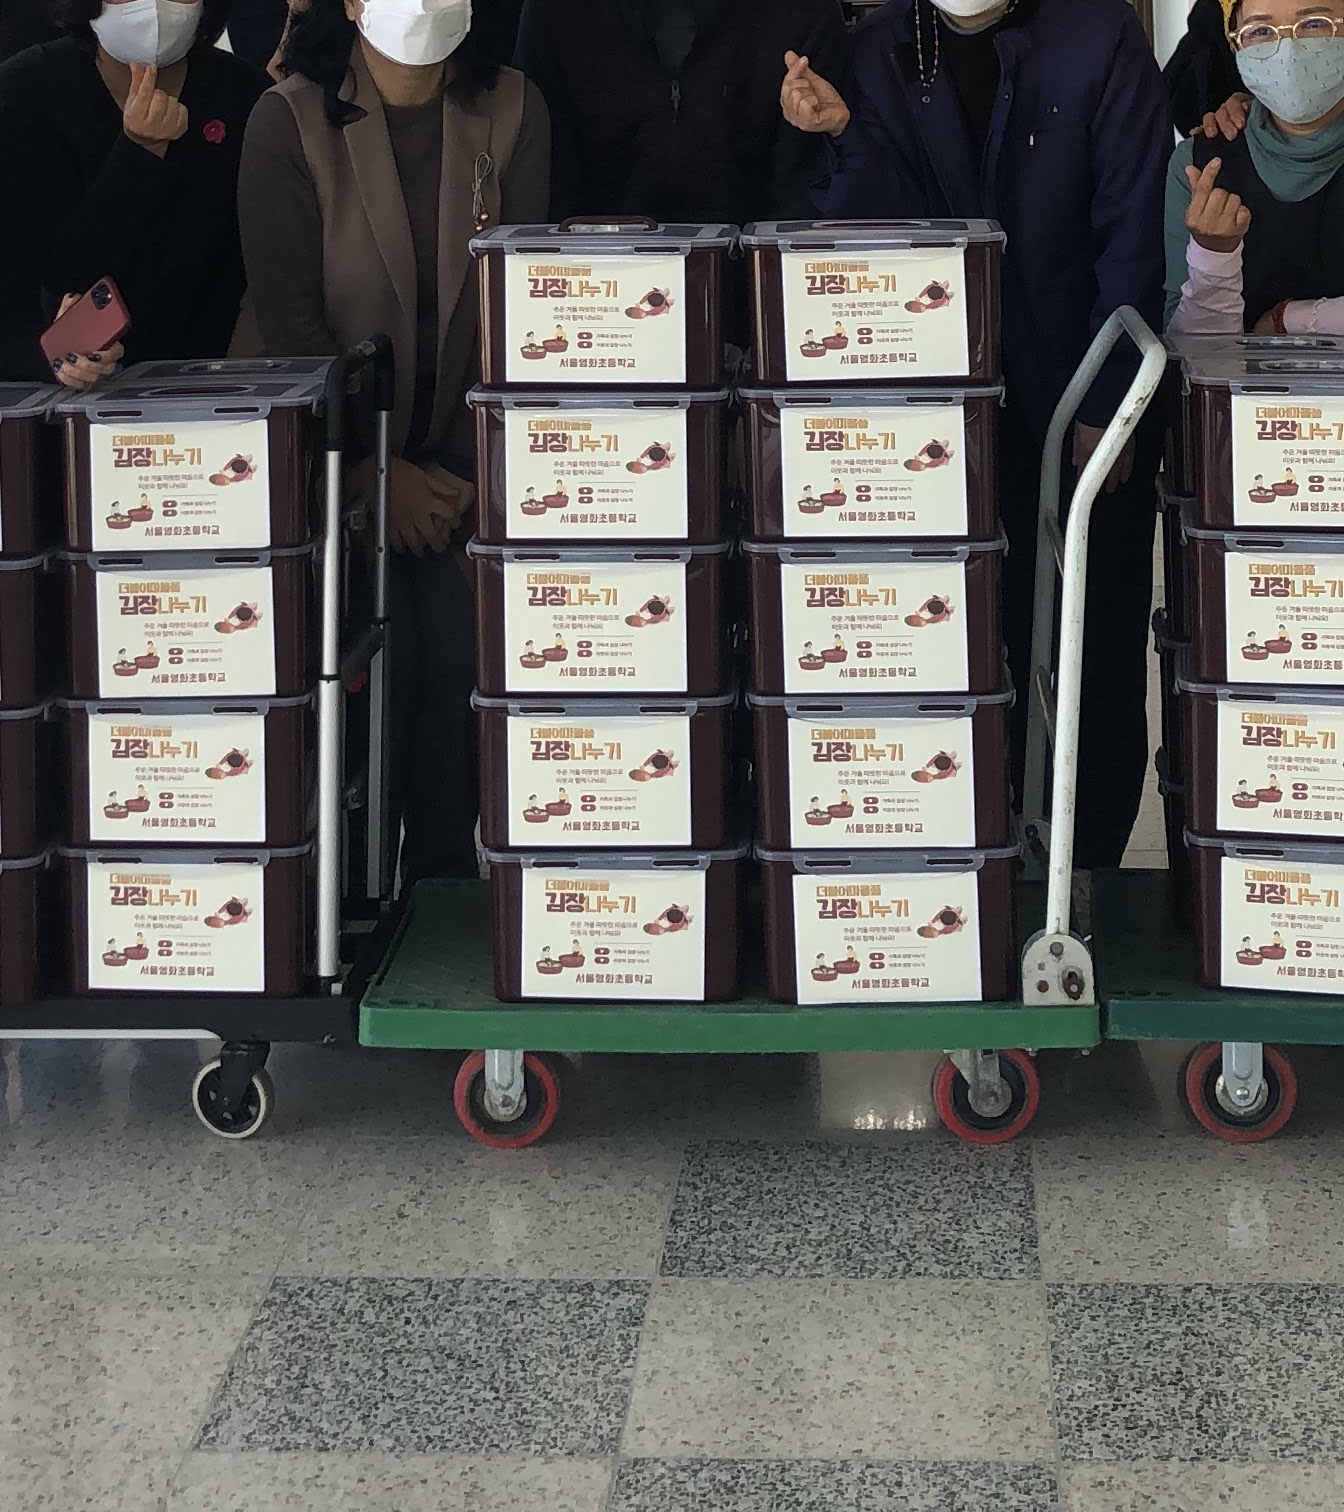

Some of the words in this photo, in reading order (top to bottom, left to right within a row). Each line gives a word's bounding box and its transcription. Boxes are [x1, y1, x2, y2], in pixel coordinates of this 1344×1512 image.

[528, 278, 618, 298] 김장나누기
[805, 272, 897, 295] 김장나누기
[528, 432, 618, 453] 김장나누기
[804, 430, 896, 451] 김장나누기
[112, 445, 202, 468] 김장나누기
[527, 586, 618, 606] 김장나누기
[804, 586, 897, 607] 김장나누기
[1249, 576, 1344, 598] 김장나누기
[118, 593, 207, 615] 김장나누기
[110, 738, 198, 759] 김장나누기
[1240, 725, 1336, 750] 김장나누기
[530, 740, 621, 761] 김장나누기
[811, 741, 904, 762] 김장나누기
[109, 885, 197, 907] 김장나누기
[544, 892, 637, 914] 김장나누기
[1244, 882, 1339, 908] 김장나누기
[816, 897, 909, 919] 김장나누기
